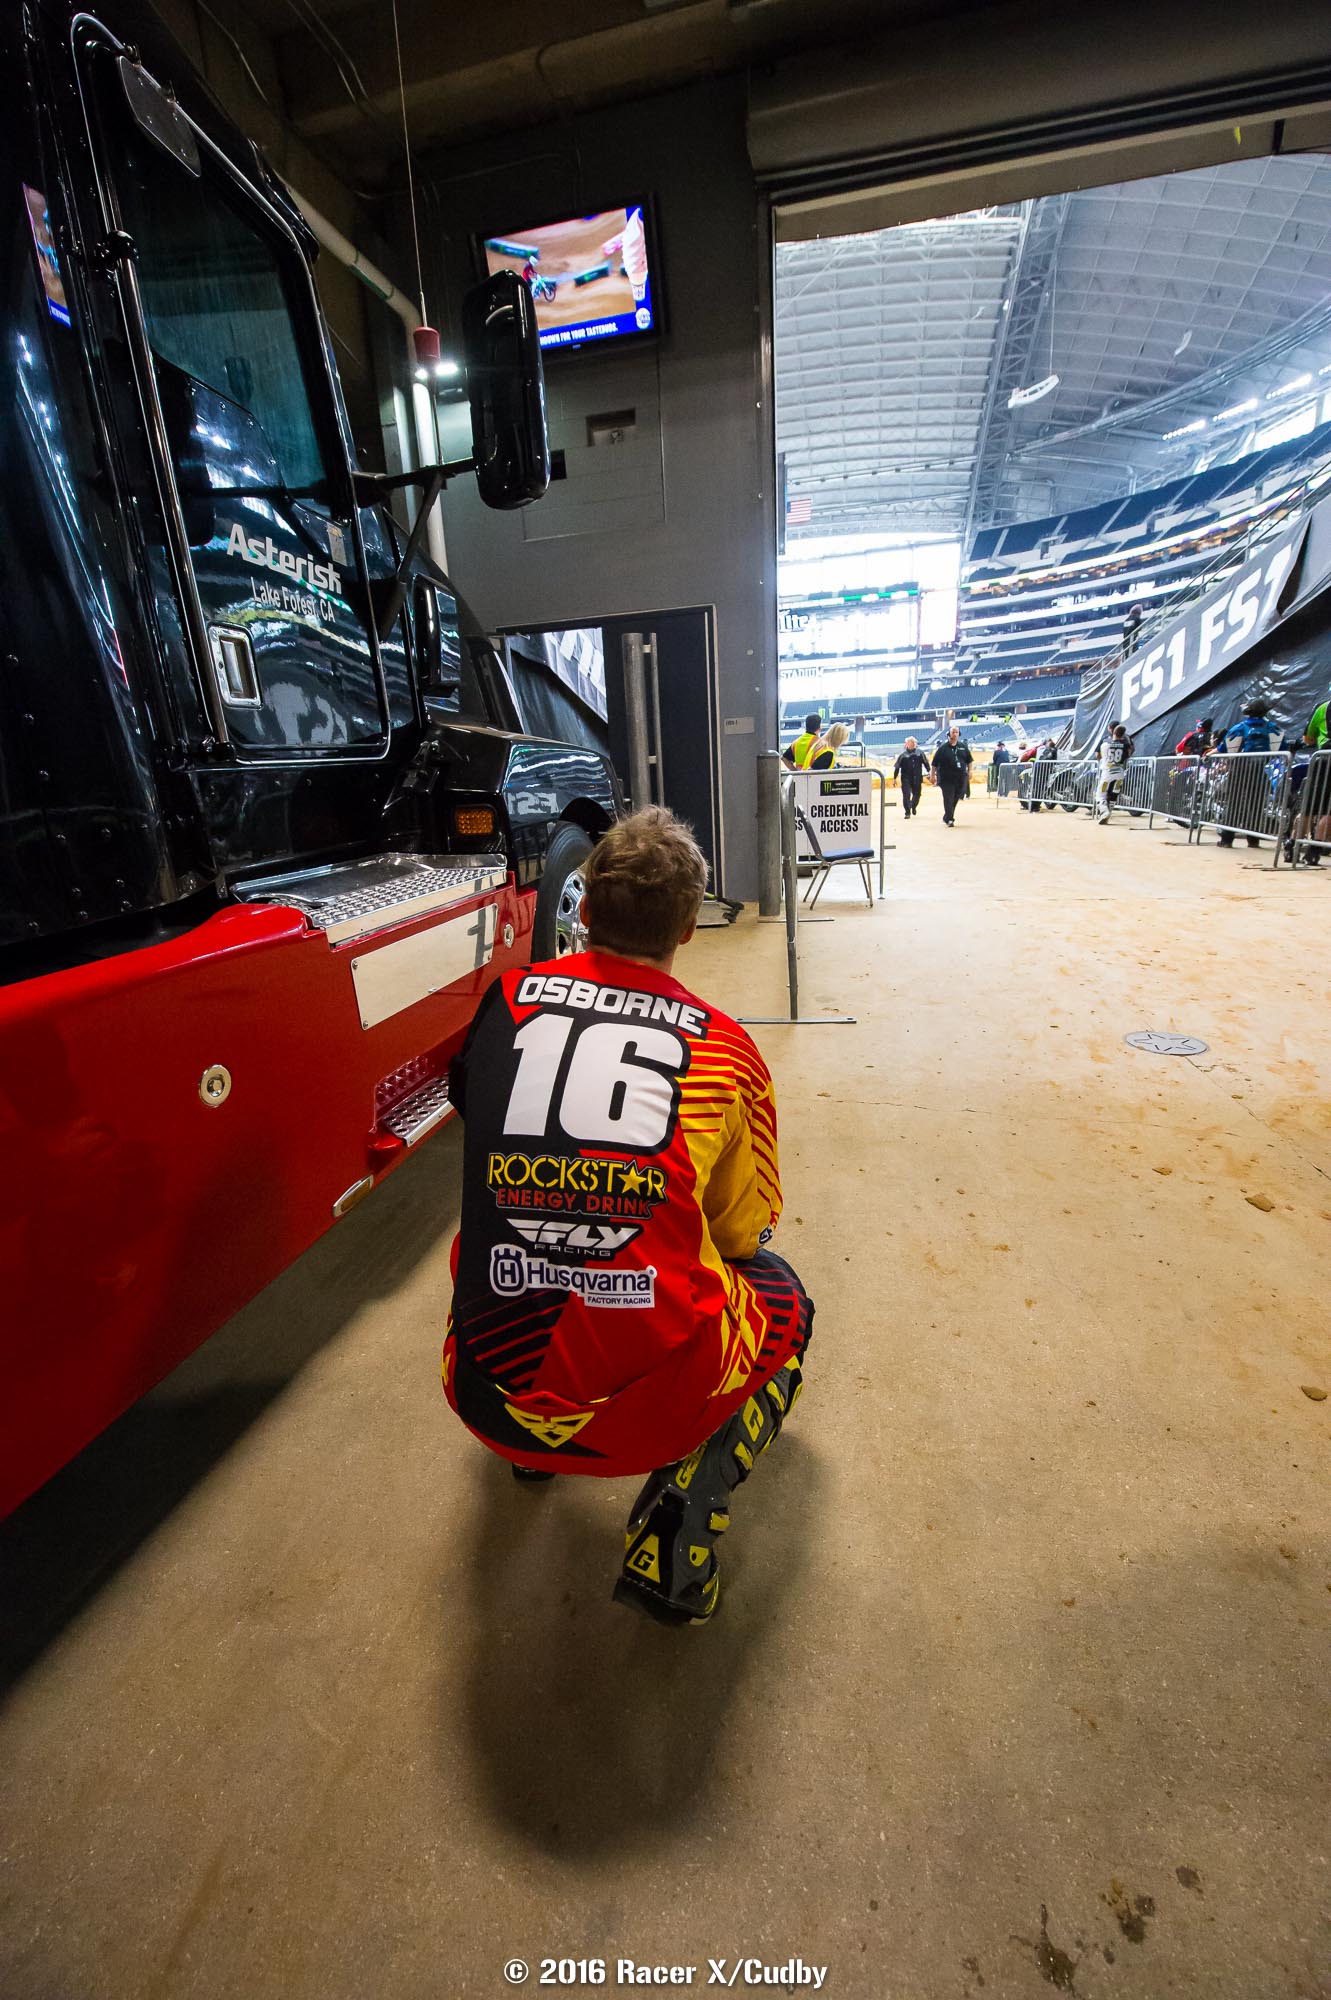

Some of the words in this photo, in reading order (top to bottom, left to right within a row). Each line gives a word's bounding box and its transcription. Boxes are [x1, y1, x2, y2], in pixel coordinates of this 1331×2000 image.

[560, 331, 571, 342] FOR
[571, 328, 586, 340] YOUR
[227, 523, 342, 594] Asterisk
[250, 576, 281, 607] Lake
[320, 598, 336, 622] CA
[1121, 627, 1186, 722] FS1
[1197, 544, 1292, 671] FS1
[811, 803, 869, 818] CREDENTIAL
[820, 819, 859, 833] ACCESS
[517, 976, 706, 1035] OSBORNE
[502, 1013, 684, 1147] 16
[497, 1188, 577, 1210] ENERGY
[586, 1195, 649, 1215] DRINK
[506, 1218, 640, 1249] FLY
[534, 1244, 611, 1257] RACING
[527, 1261, 651, 1293] Husqvarna
[587, 1297, 621, 1305] FACTORY
[623, 1297, 651, 1305] RACING
